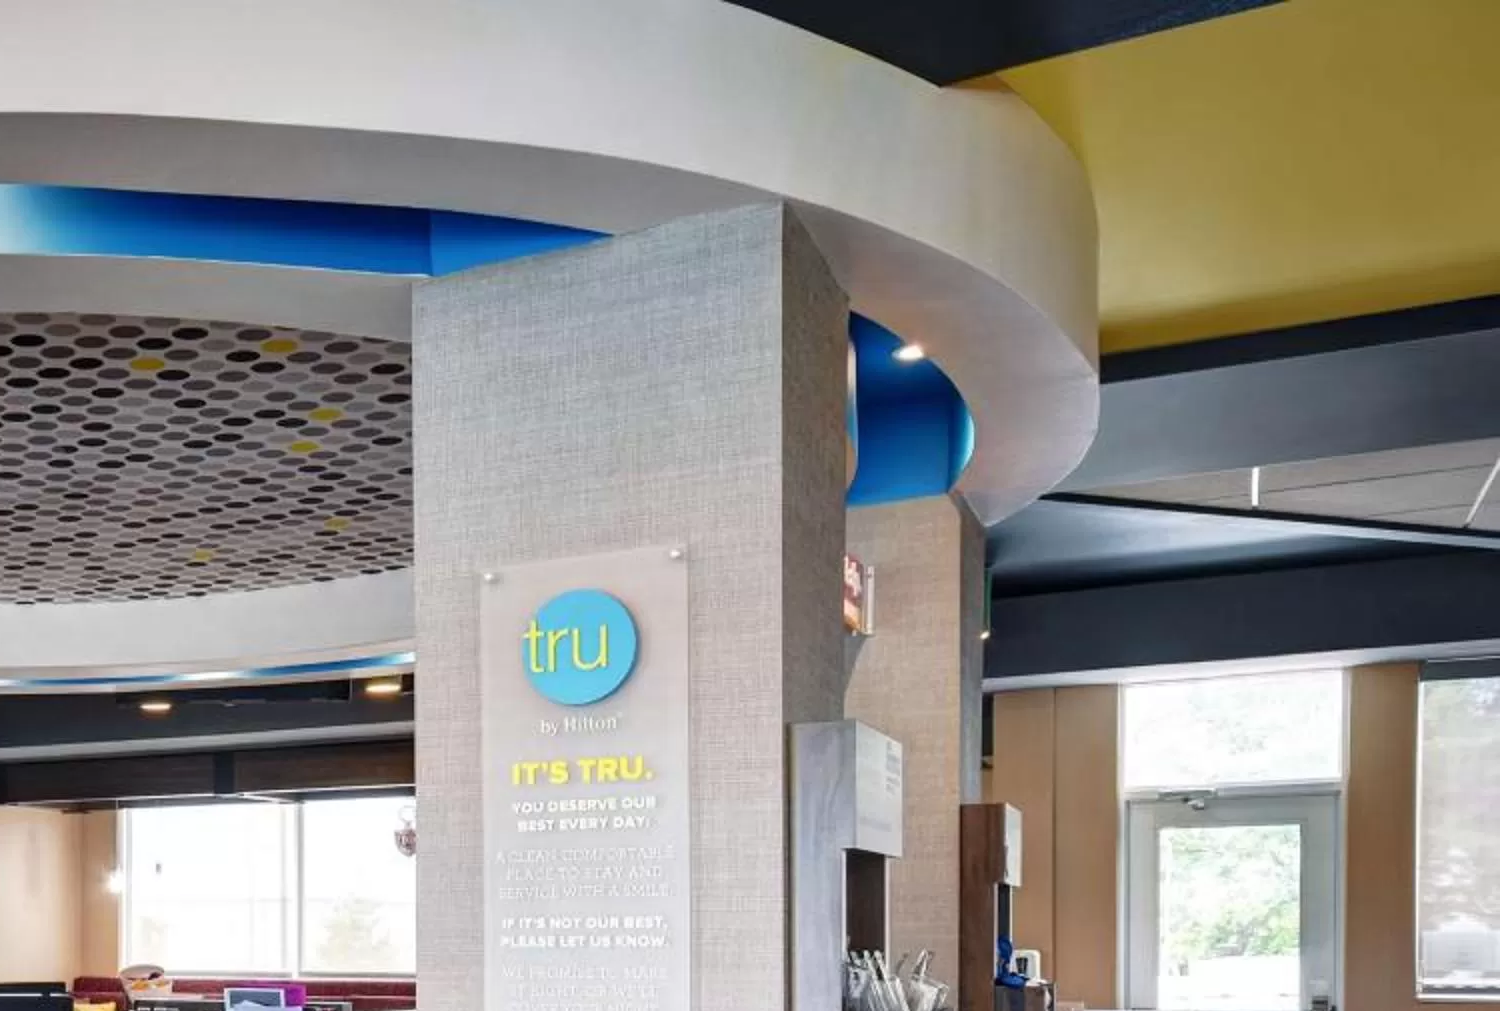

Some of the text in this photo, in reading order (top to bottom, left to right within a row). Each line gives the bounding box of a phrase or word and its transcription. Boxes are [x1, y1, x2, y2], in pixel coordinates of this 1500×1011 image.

[522, 619, 609, 673] tru
[540, 715, 617, 736] by Hilton
[511, 755, 654, 786] IT'S TRU.
[511, 796, 657, 814] YOU DESERVE OUR
[517, 819, 555, 832] BEST
[559, 817, 609, 830] EVERY
[501, 917, 514, 929] IF
[518, 917, 547, 929] IT'S
[550, 916, 581, 929] NOT
[585, 916, 619, 929] OUR
[499, 935, 556, 948] PLEASE
[559, 935, 585, 948] LET
[589, 935, 610, 948] US
